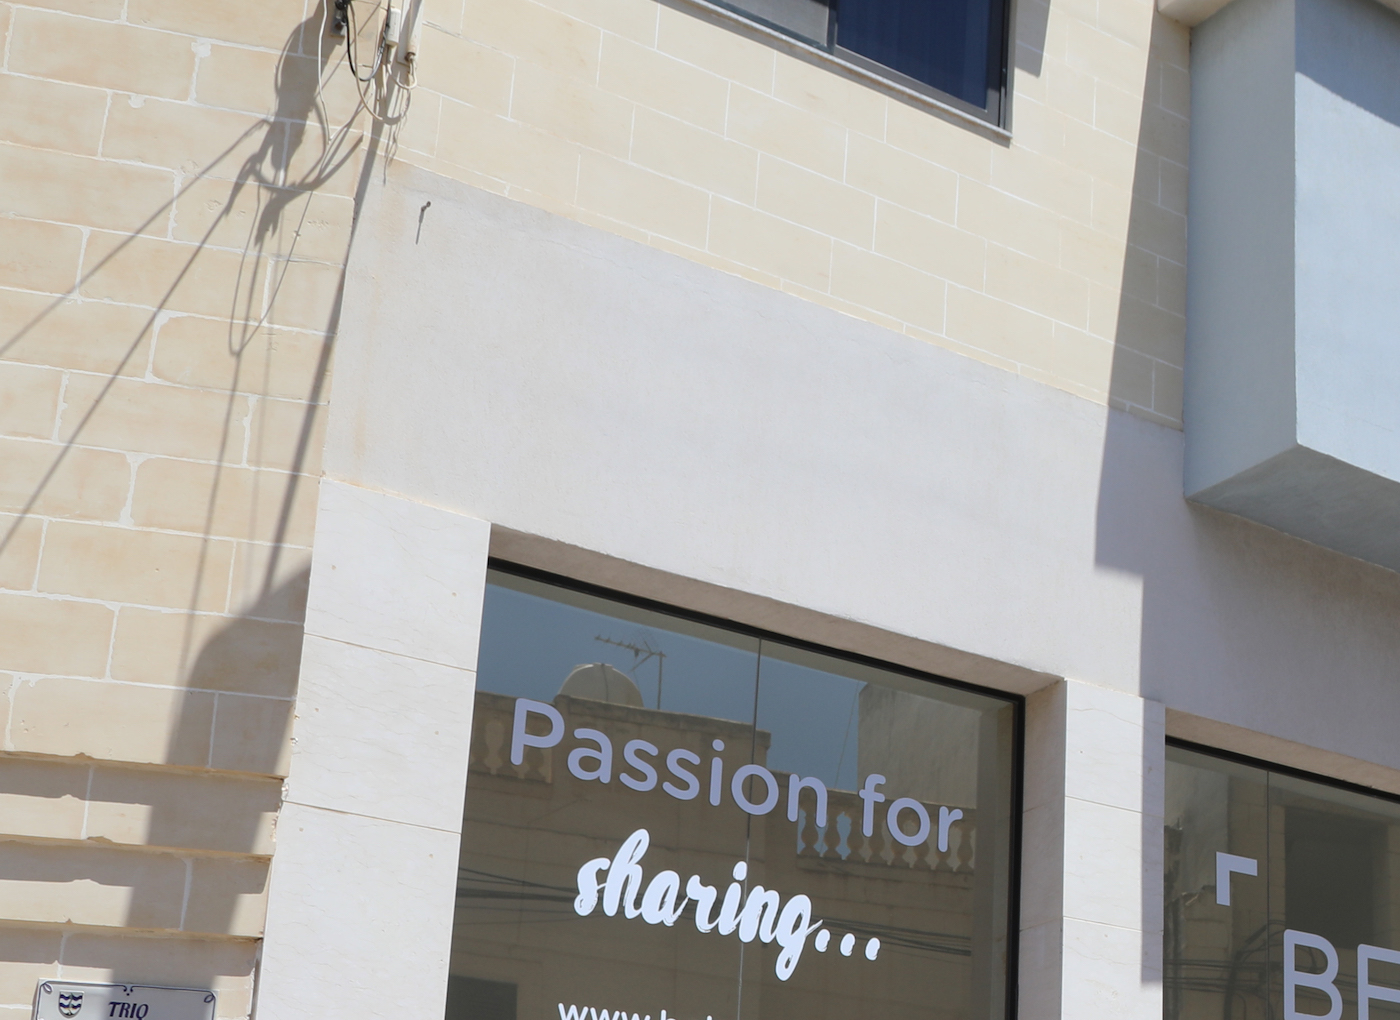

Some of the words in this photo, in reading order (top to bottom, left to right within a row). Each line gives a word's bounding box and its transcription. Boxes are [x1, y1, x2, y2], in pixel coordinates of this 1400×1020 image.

[510, 697, 828, 829] Passion
[858, 773, 963, 853] for
[573, 828, 881, 981] sharing...
